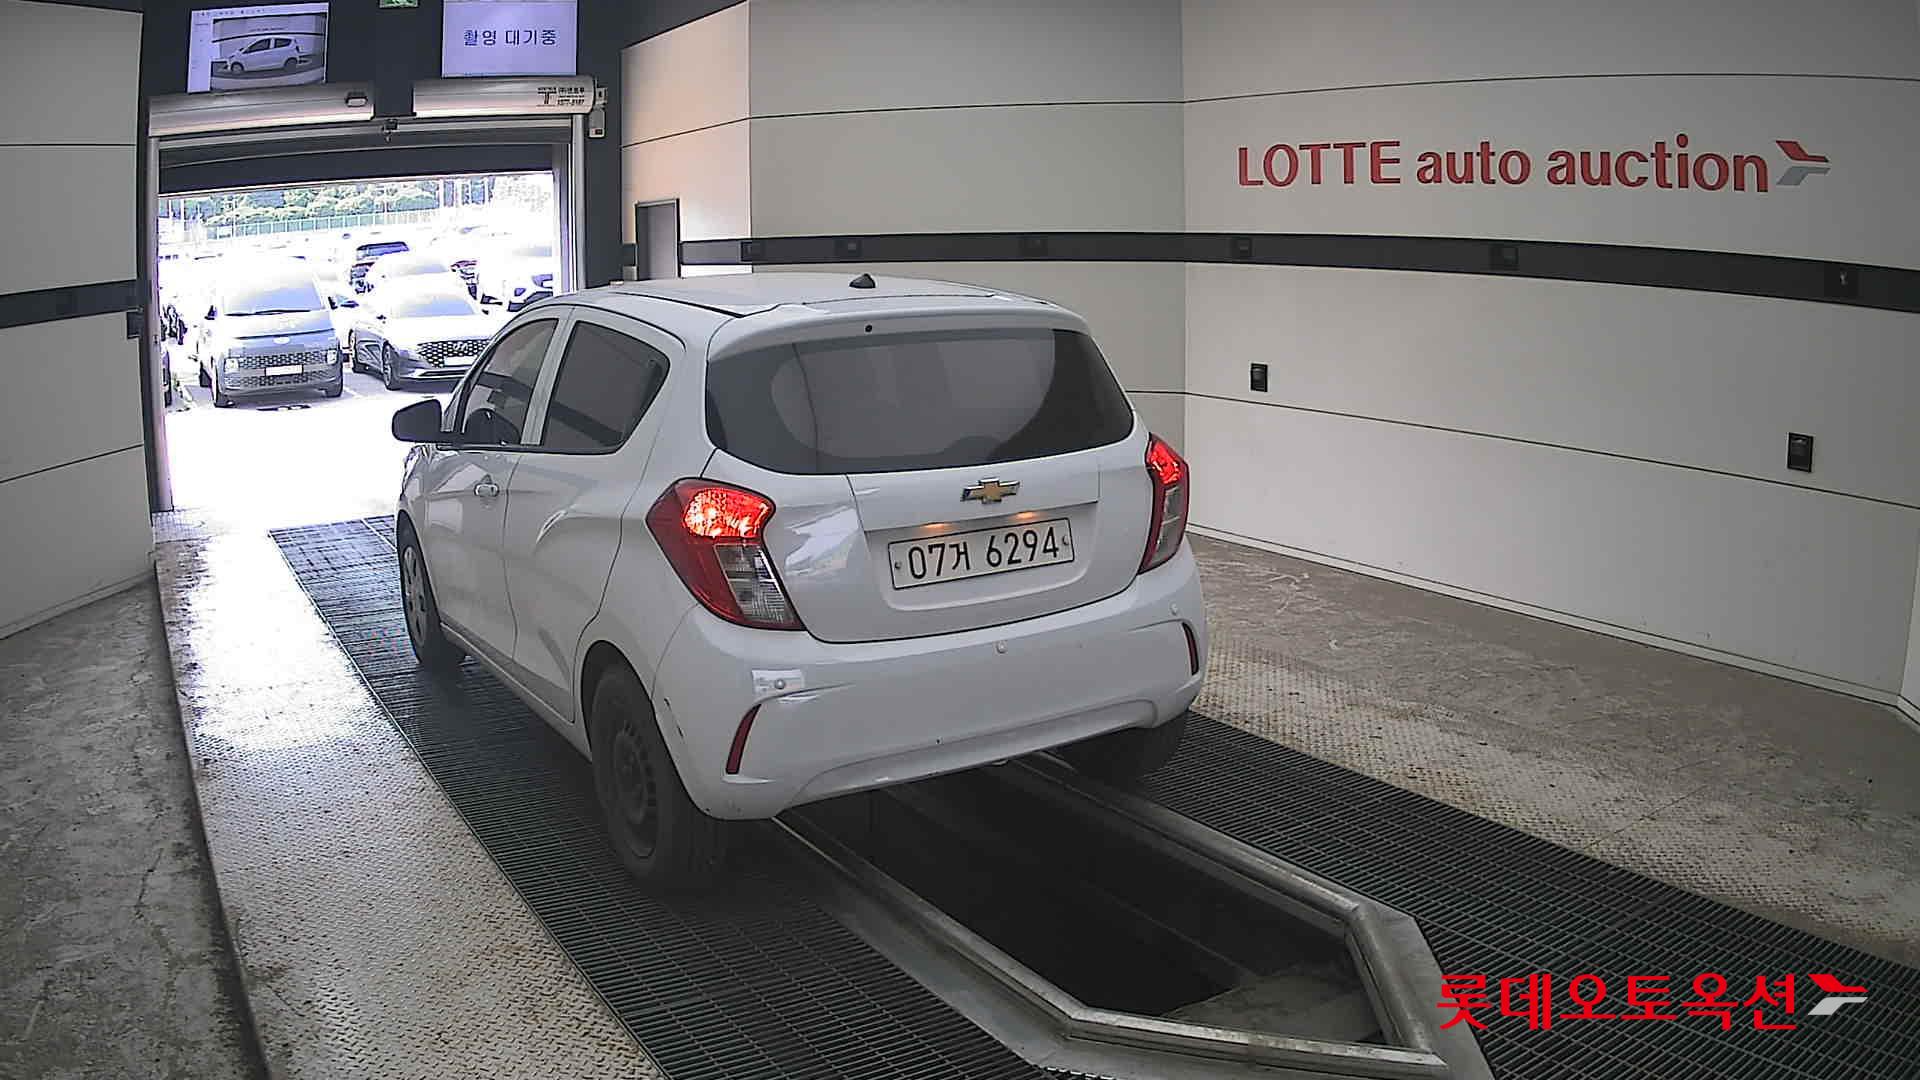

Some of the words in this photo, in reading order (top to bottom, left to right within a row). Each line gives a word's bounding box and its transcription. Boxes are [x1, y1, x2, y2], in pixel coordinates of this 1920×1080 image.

[463, 29, 497, 46] 촬영
[505, 29, 556, 46] 대기중
[1237, 141, 1401, 187] LOTTE
[1416, 141, 1530, 184] auto
[1547, 134, 1769, 192] auction
[908, 542, 971, 580] 07거
[985, 526, 1060, 568] 6294
